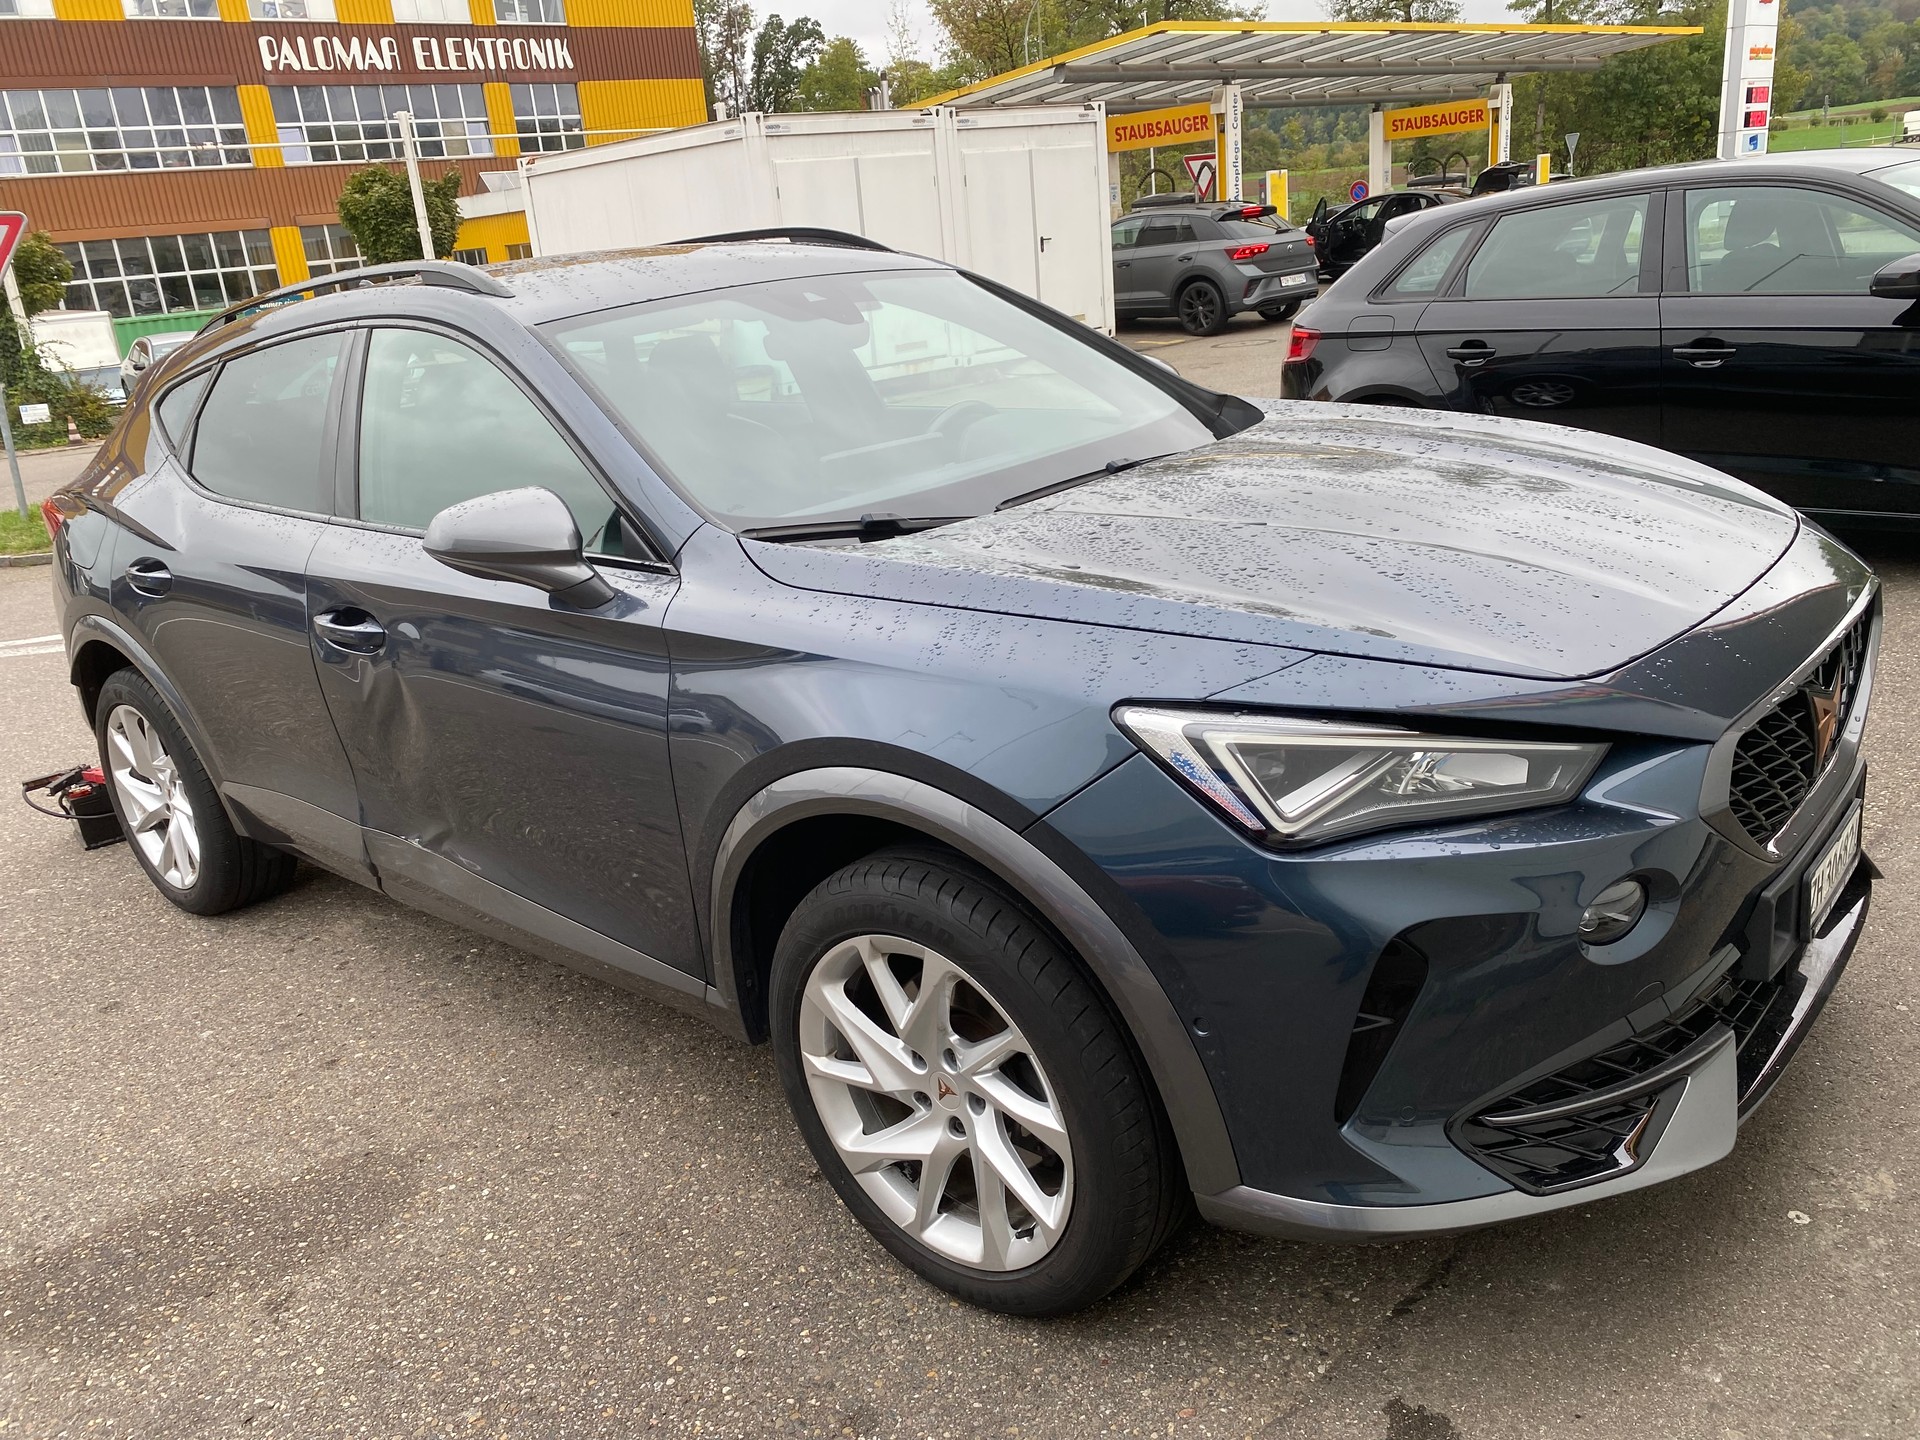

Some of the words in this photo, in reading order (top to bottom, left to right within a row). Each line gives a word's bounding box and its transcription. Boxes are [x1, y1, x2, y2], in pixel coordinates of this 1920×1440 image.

[258, 35, 401, 71] PALOMAR
[412, 37, 574, 70] ELEKTRONIK
[1115, 114, 1209, 142] STAUBSAUGER
[1392, 108, 1484, 133] STAUBSAUGER
